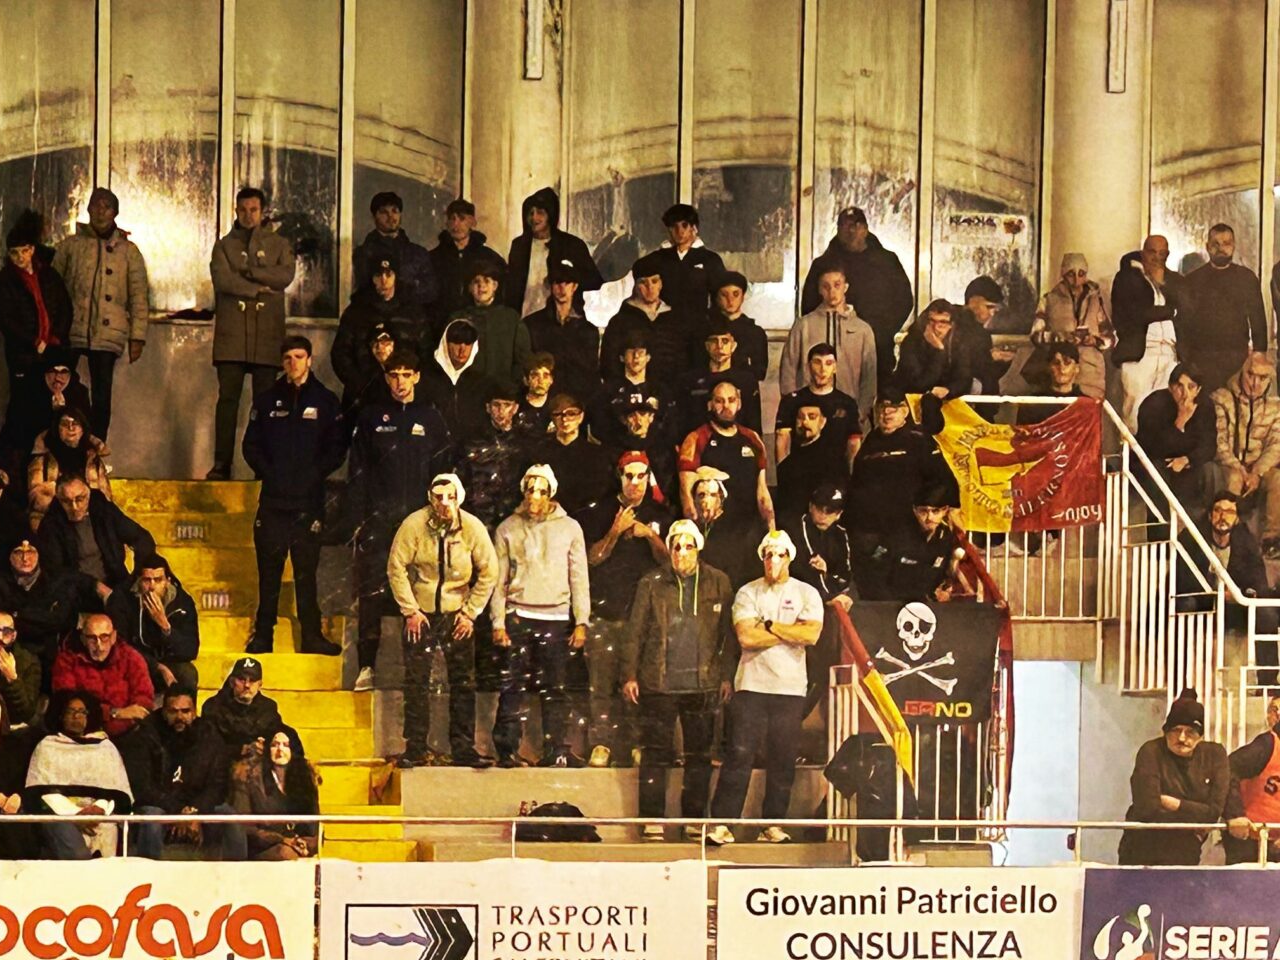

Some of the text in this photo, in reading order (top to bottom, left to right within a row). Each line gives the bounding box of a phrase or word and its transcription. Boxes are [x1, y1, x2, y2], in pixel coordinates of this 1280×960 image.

[1050, 503, 1102, 523] njoy
[745, 885, 1057, 916] Giovanni Patriciello
[492, 906, 648, 925] TRASPORTI
[492, 932, 648, 952] PORTUALI
[786, 931, 1022, 960] CONSULENZA
[1165, 926, 1270, 960] SERIE
